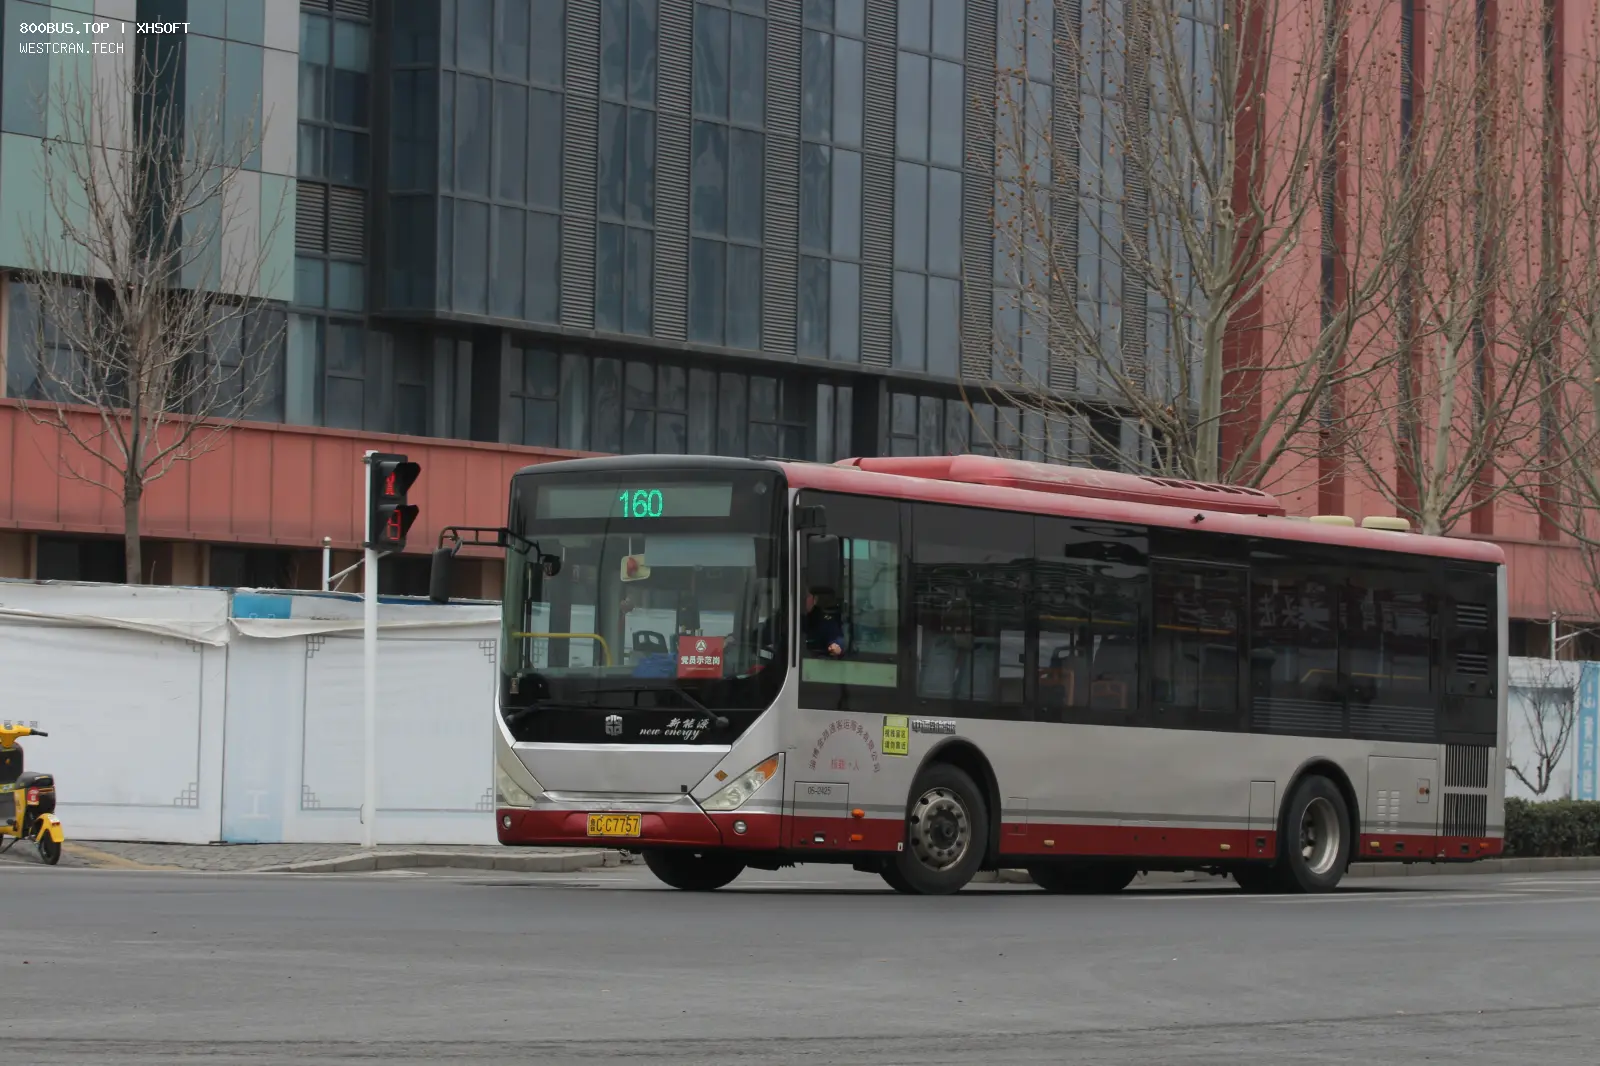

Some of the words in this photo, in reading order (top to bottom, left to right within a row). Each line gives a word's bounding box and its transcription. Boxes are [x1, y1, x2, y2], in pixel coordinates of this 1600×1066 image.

[619, 489, 663, 518] 160
[680, 655, 721, 666] 党员示范岗
[666, 717, 710, 729] 新能源
[639, 728, 661, 736] new
[664, 728, 701, 741] energy
